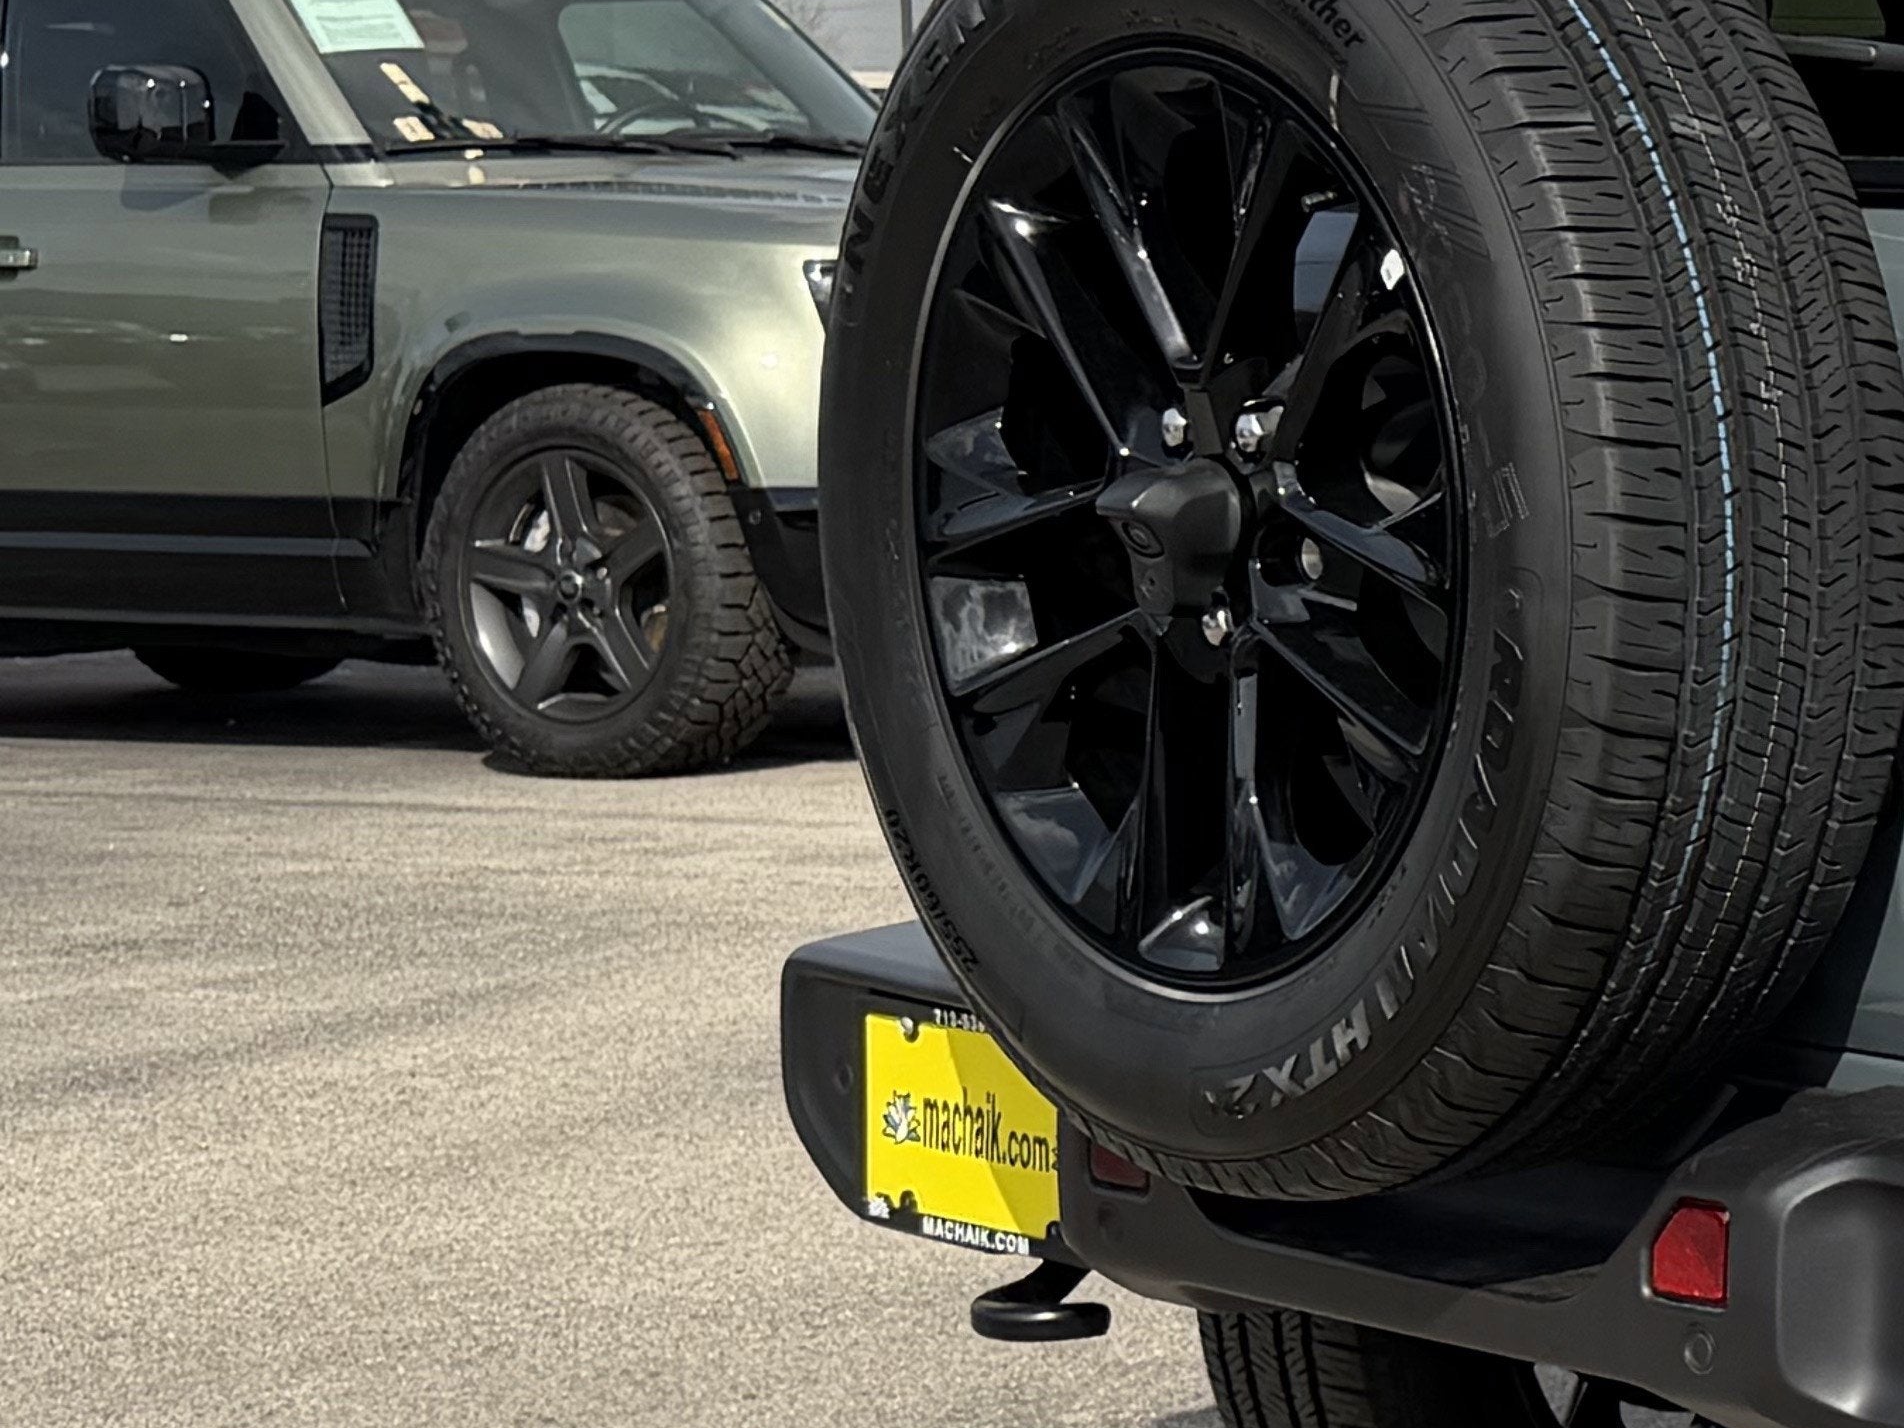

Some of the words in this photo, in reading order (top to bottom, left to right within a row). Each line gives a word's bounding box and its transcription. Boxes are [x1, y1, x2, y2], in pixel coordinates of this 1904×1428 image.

[1220, 998, 1372, 1120] HTX2
[922, 1085, 1051, 1173] machaik.com
[922, 1217, 1031, 1256] MACHAIK.COM
